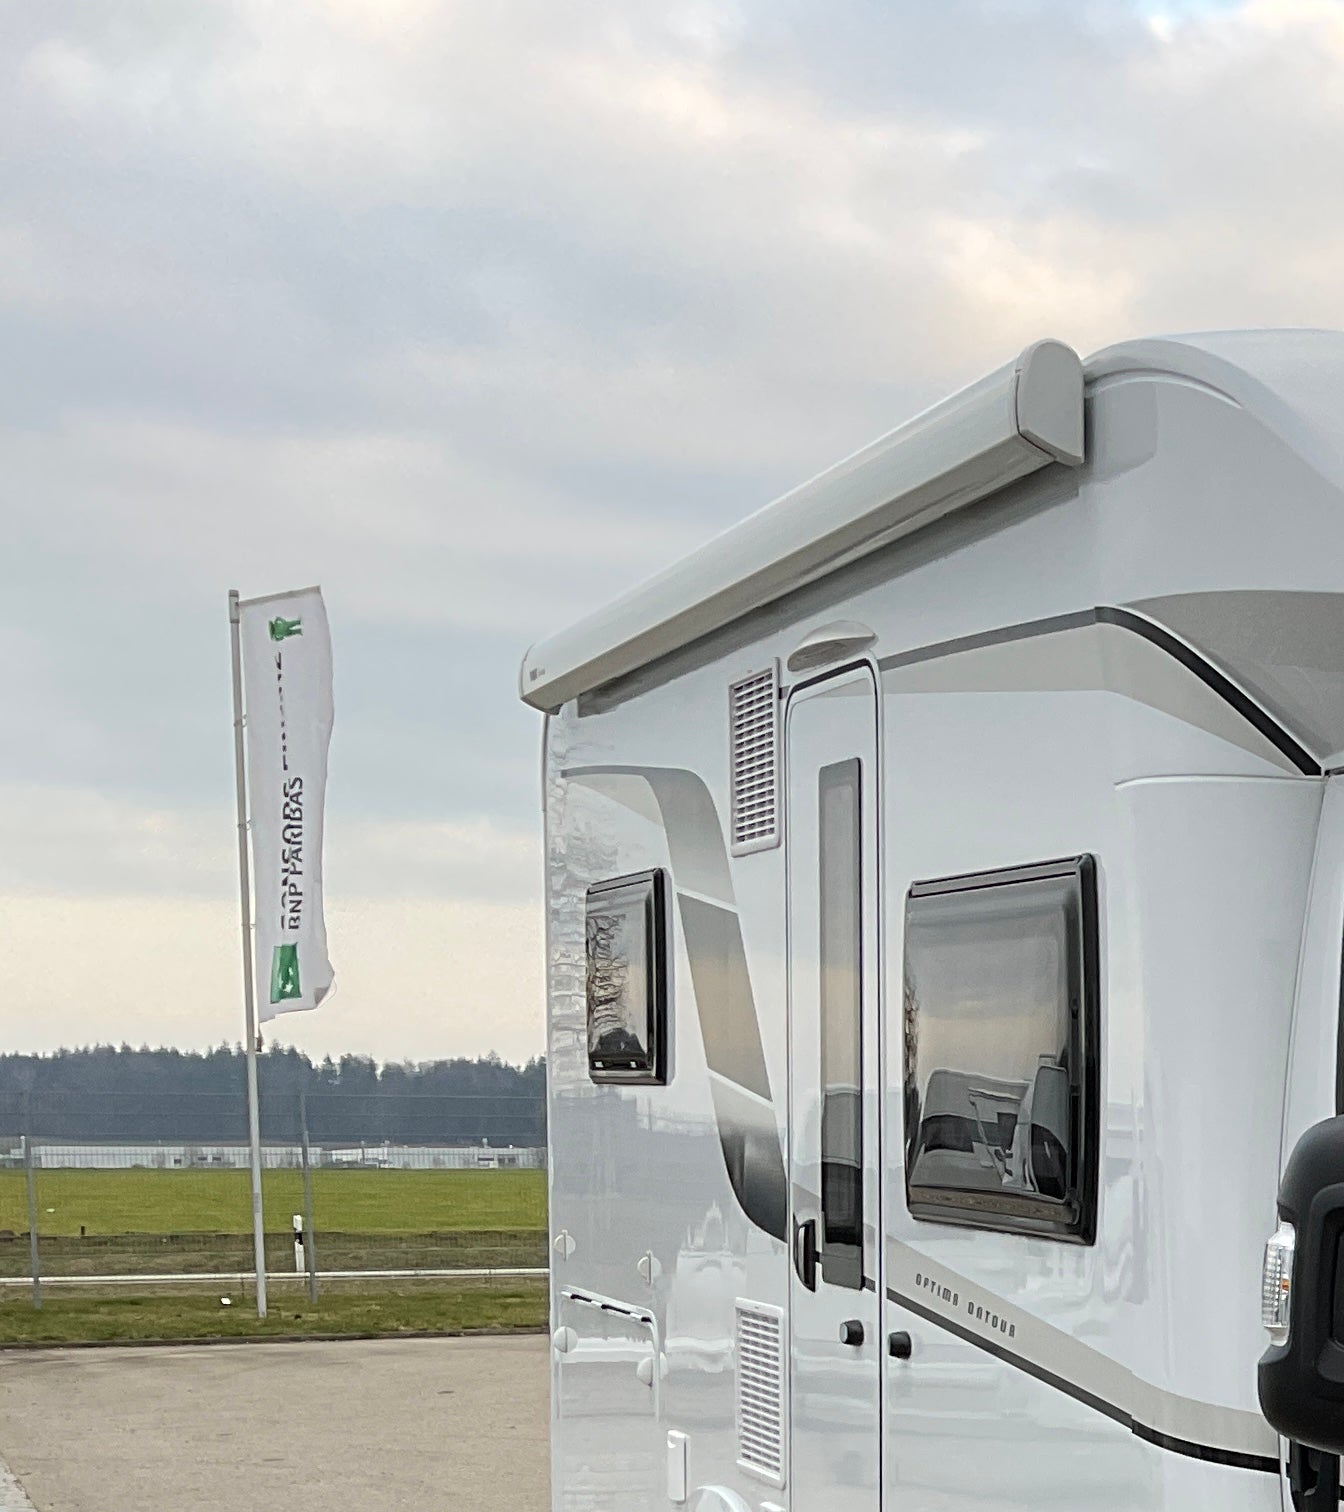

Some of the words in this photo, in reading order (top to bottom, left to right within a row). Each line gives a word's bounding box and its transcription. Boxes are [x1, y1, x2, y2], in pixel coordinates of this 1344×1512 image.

[289, 776, 304, 876] PARIBAS
[288, 882, 304, 930] BNP
[915, 1272, 960, 1307] OPTIMA
